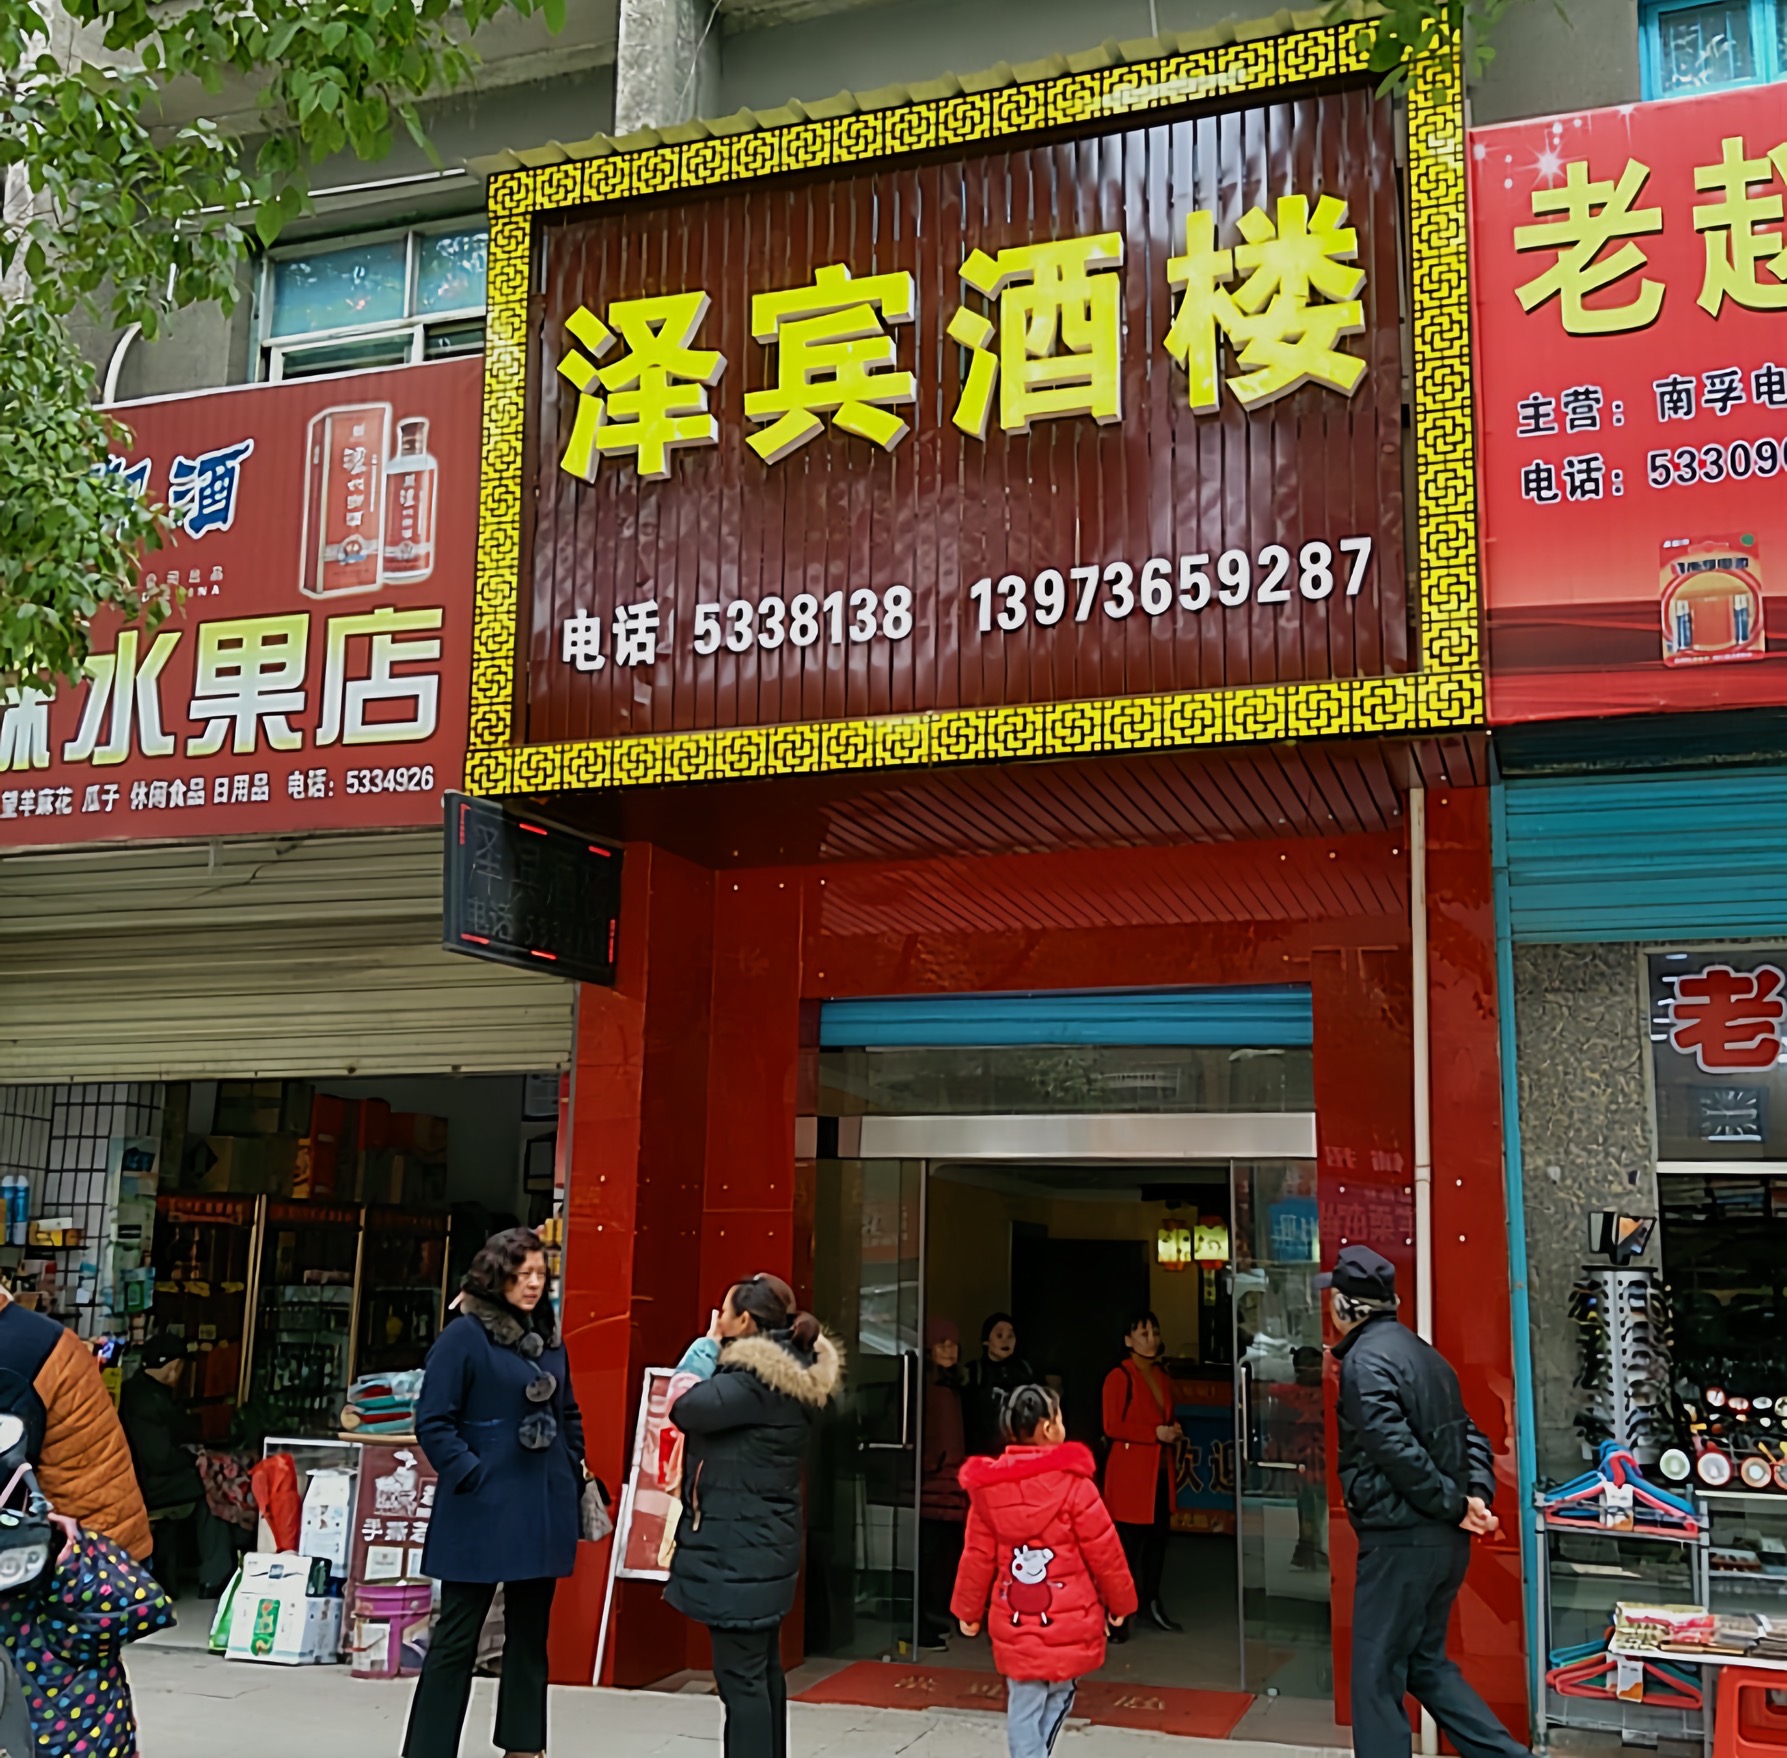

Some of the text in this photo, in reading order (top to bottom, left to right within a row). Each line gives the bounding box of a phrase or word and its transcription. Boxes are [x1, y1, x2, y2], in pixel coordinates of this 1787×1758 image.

[556, 193, 1367, 484] 泽宾酒楼
[1520, 436, 1787, 504] 电话： 53309
[561, 536, 1373, 672] 电话 5338138 13973659287
[130, 778, 205, 811] 休闲食品
[213, 773, 270, 803] 日用品
[346, 765, 434, 794] 5334926
[1668, 964, 1787, 1074] 老
